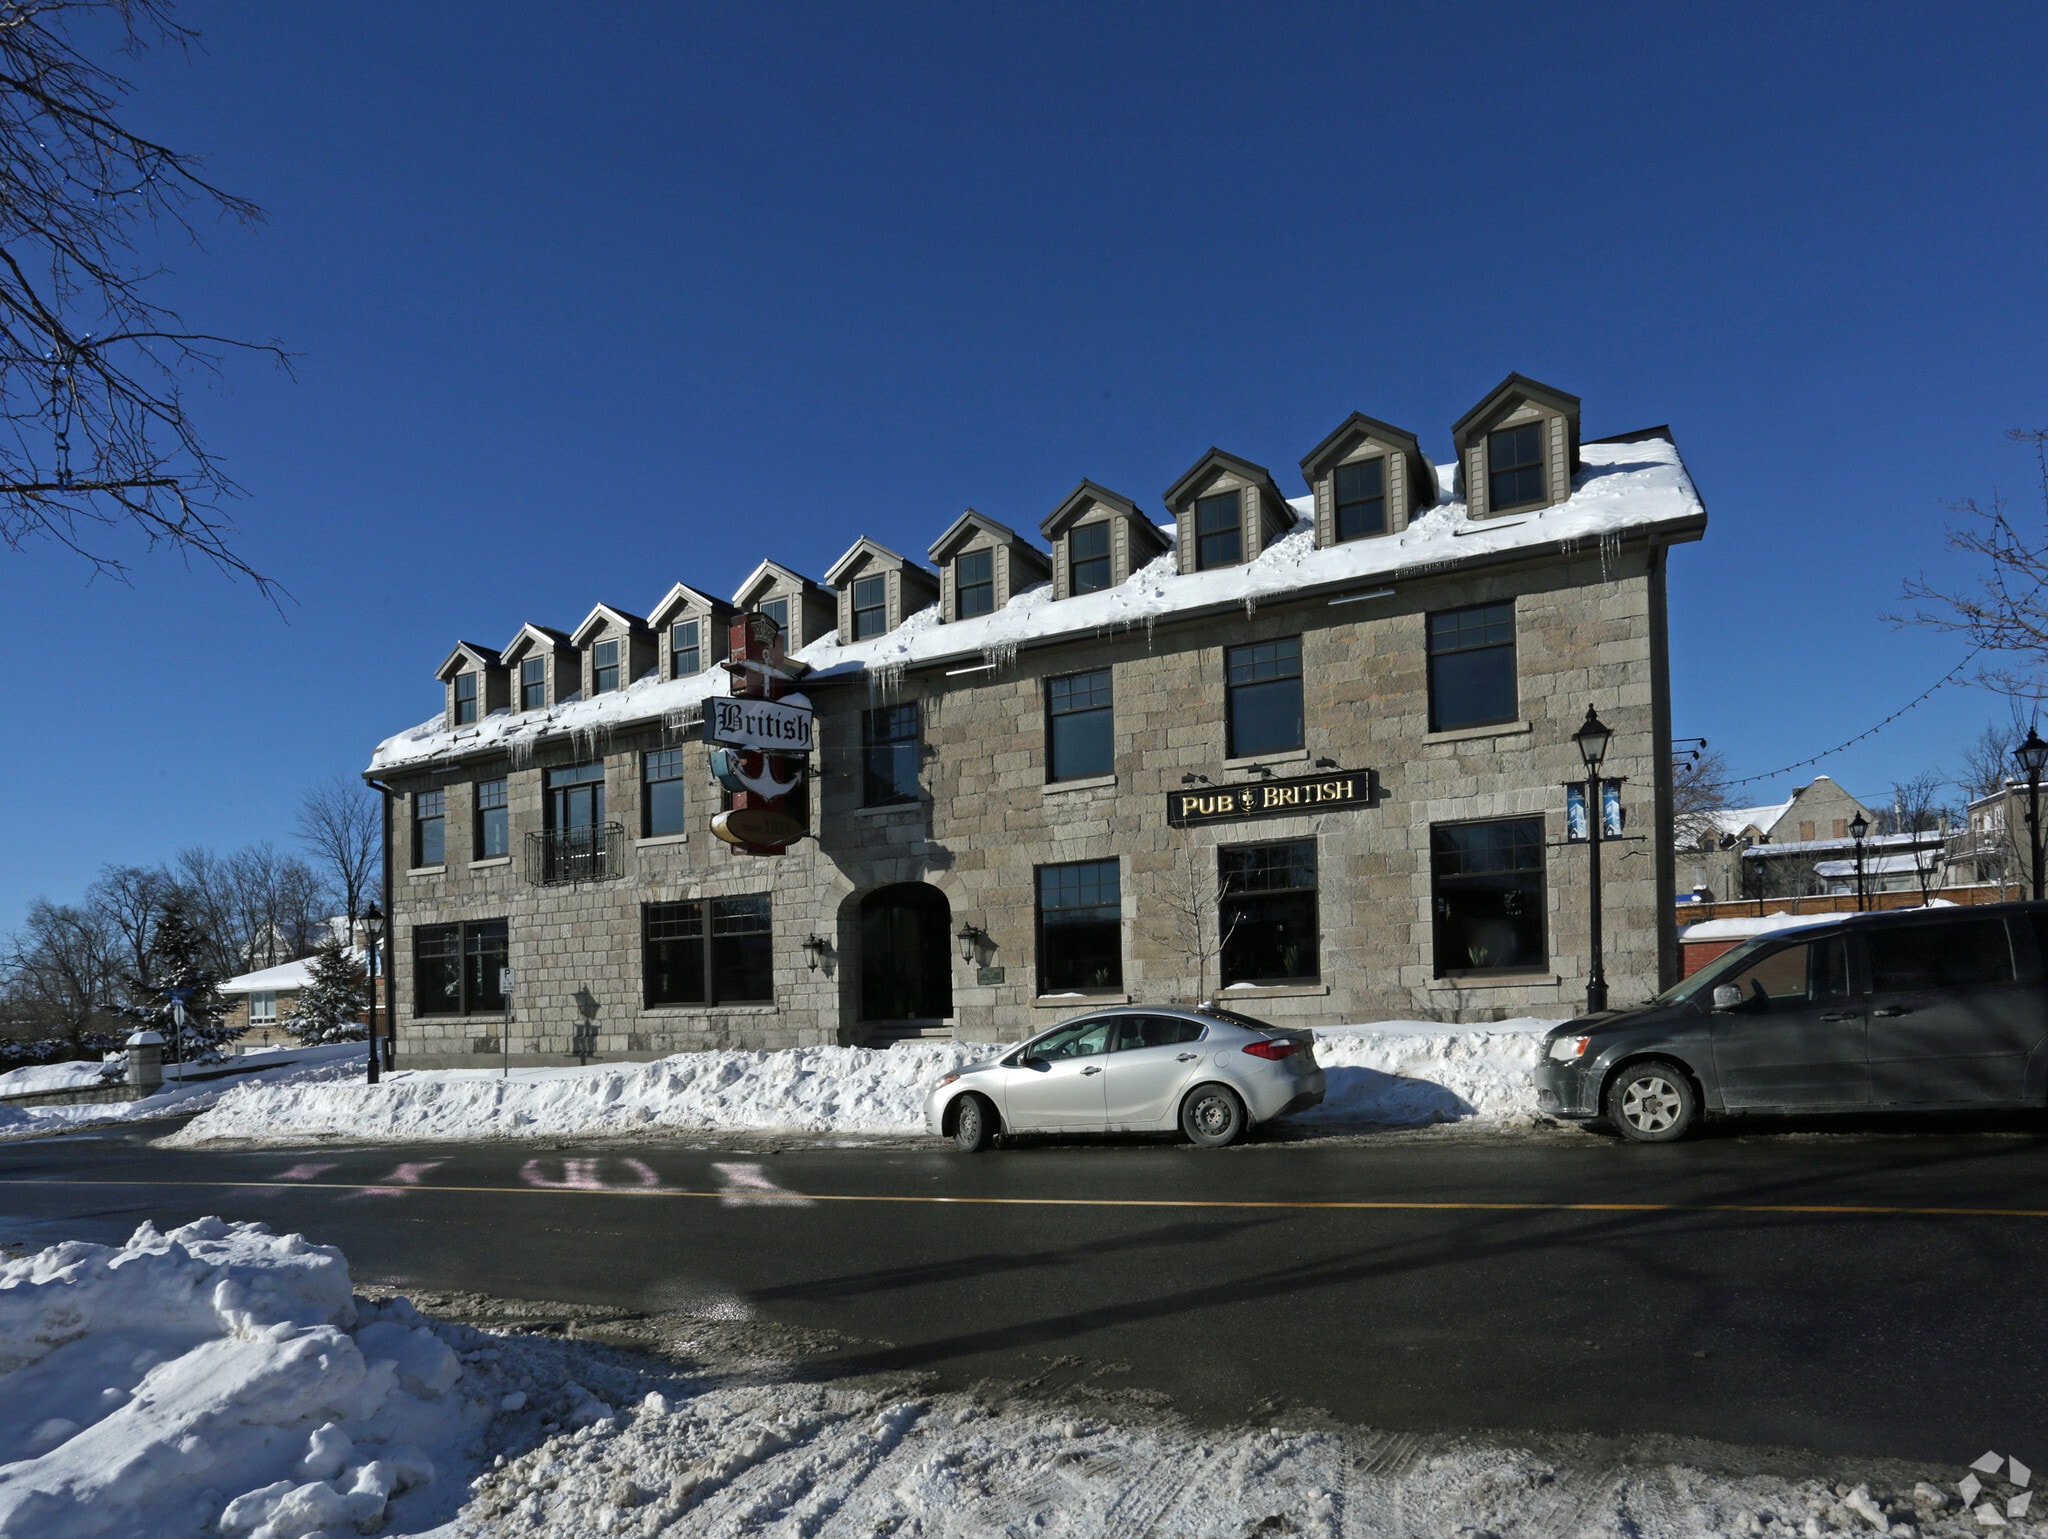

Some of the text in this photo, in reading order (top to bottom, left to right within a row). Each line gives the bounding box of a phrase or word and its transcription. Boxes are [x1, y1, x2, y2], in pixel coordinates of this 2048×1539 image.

[717, 702, 809, 746] British
[1182, 781, 1354, 817] PUB BRITISH
